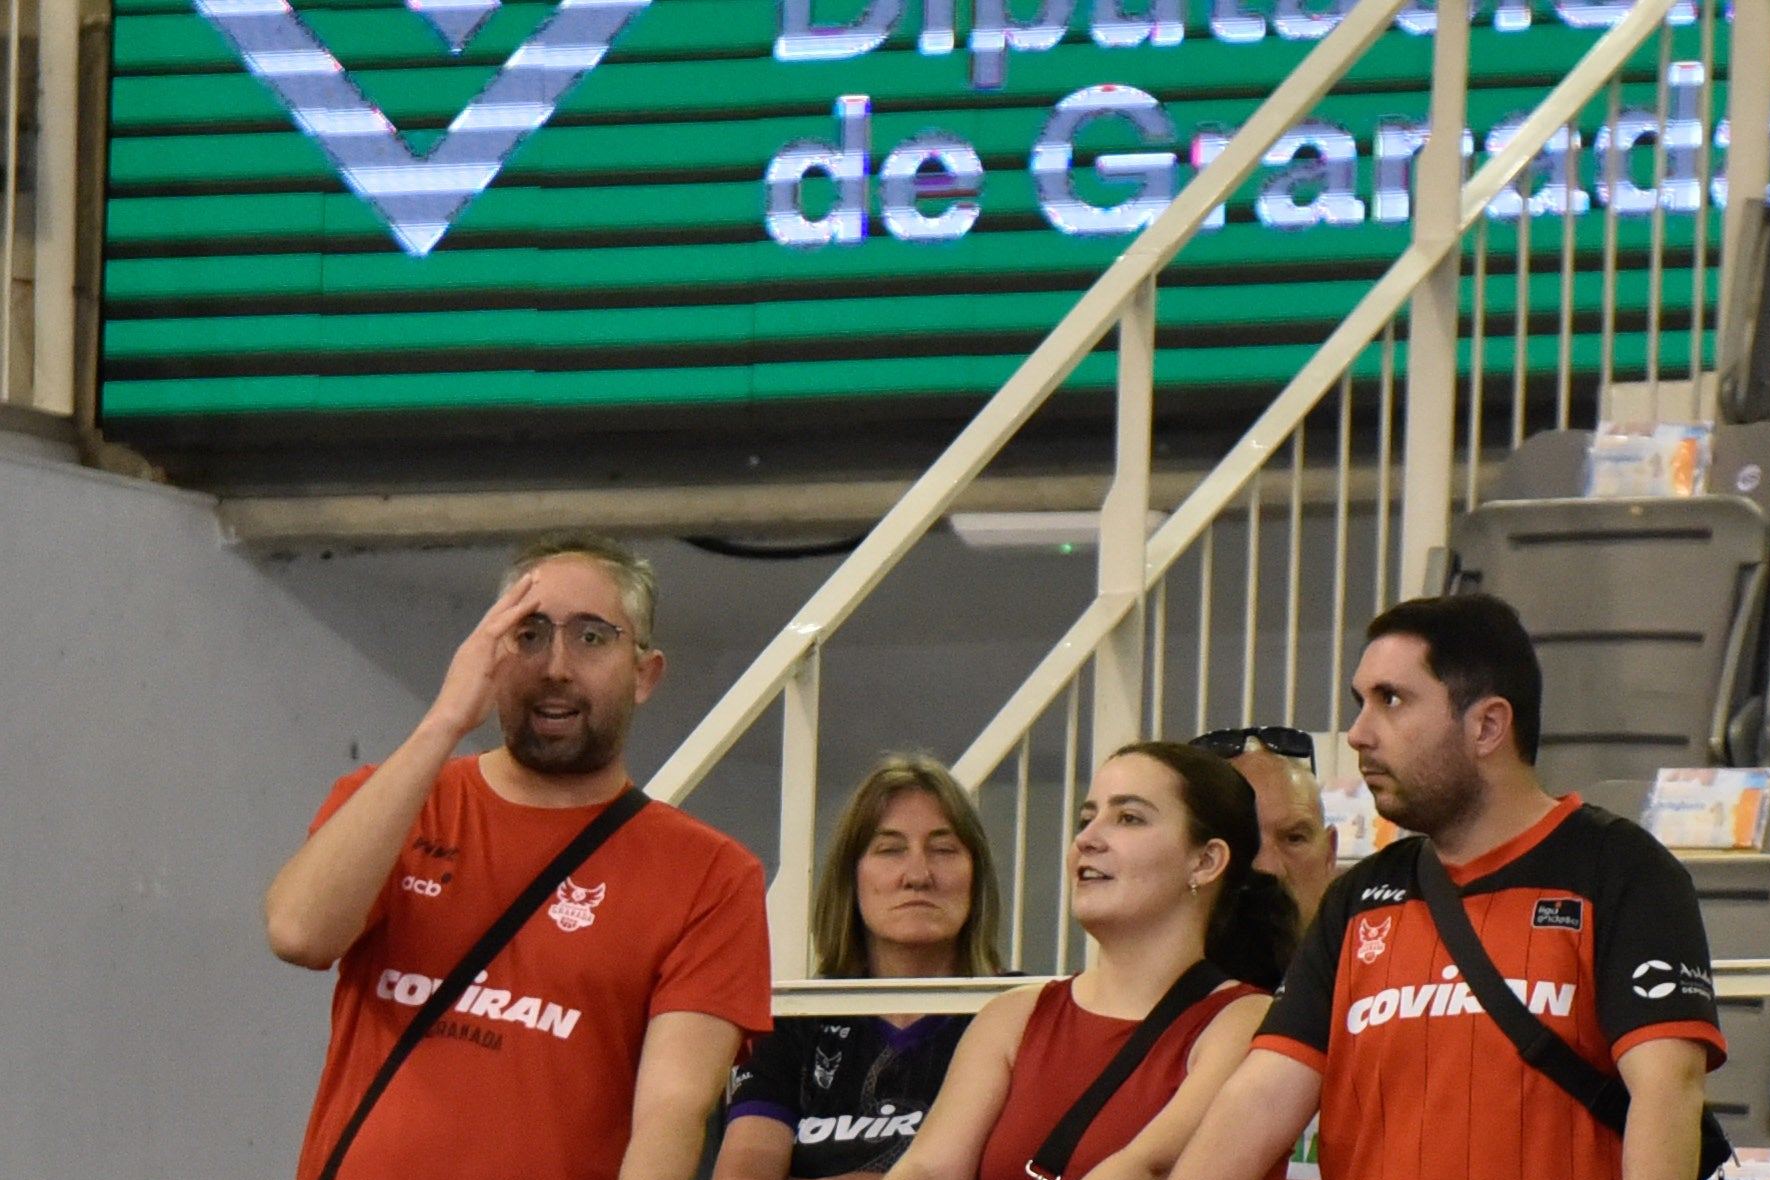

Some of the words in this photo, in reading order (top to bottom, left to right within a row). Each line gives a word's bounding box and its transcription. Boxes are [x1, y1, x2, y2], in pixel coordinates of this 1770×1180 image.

[765, 94, 983, 246] de
[402, 876, 442, 897] acb
[1361, 883, 1406, 902] vive
